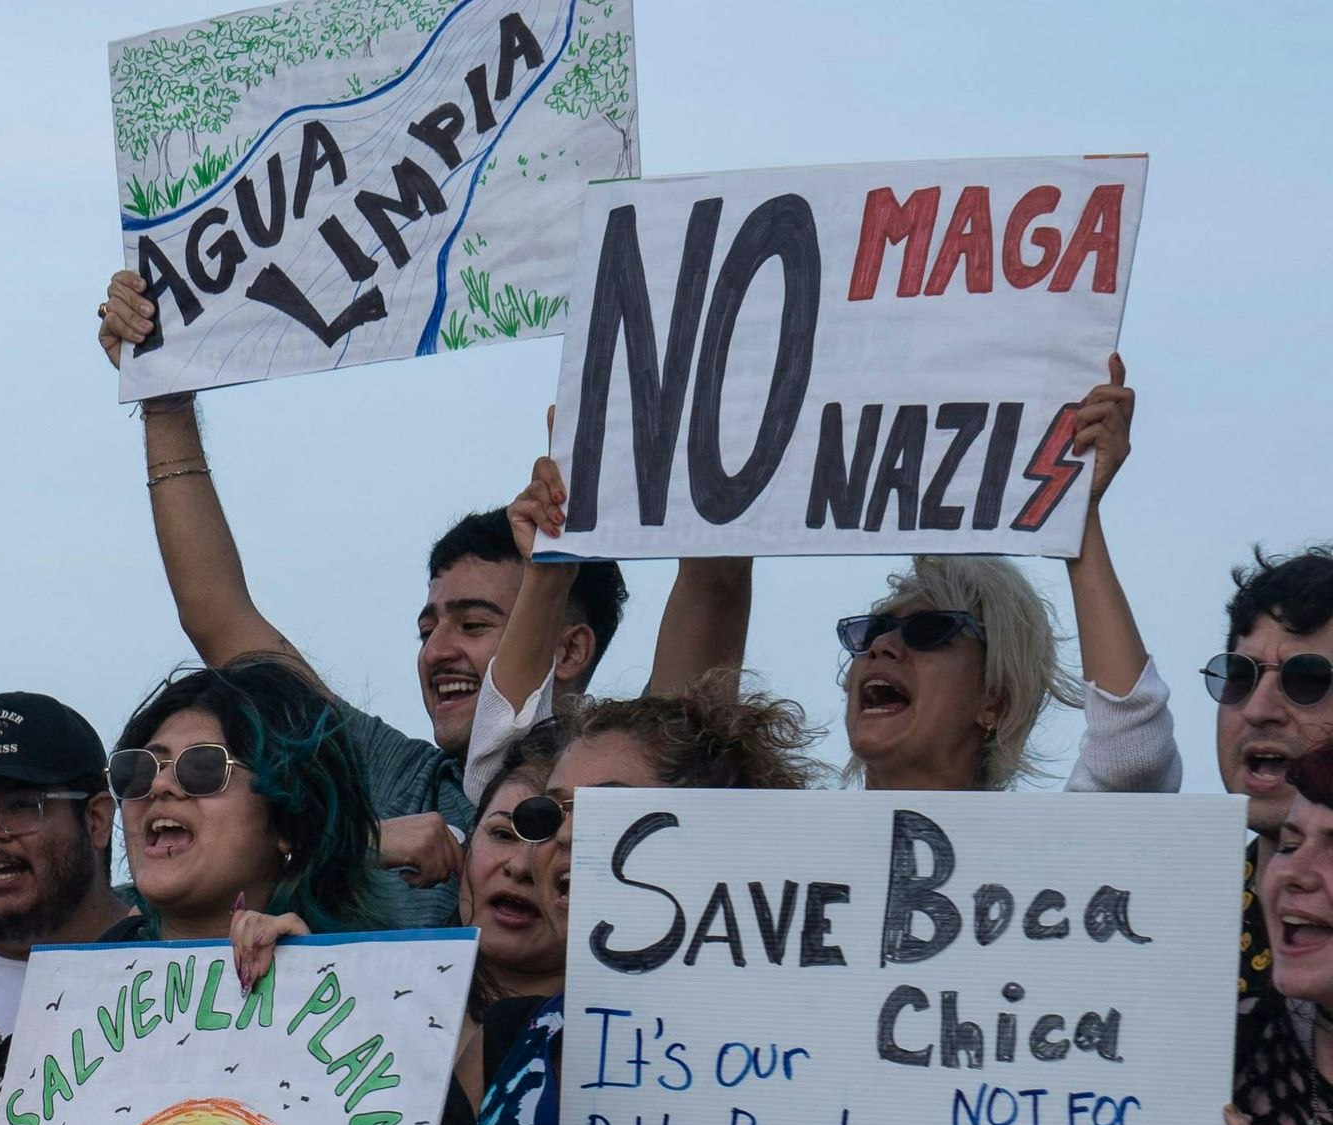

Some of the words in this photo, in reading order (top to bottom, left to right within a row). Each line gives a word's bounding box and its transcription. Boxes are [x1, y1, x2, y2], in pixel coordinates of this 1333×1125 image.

[134, 120, 347, 358] AGUA
[245, 12, 544, 348] LIMPIA
[566, 193, 821, 532] NO
[847, 184, 1125, 301] MAGA
[589, 811, 851, 975] SAVE
[880, 809, 1154, 969] Boca
[581, 1007, 693, 1091] It's
[877, 981, 1125, 1069] Chica
